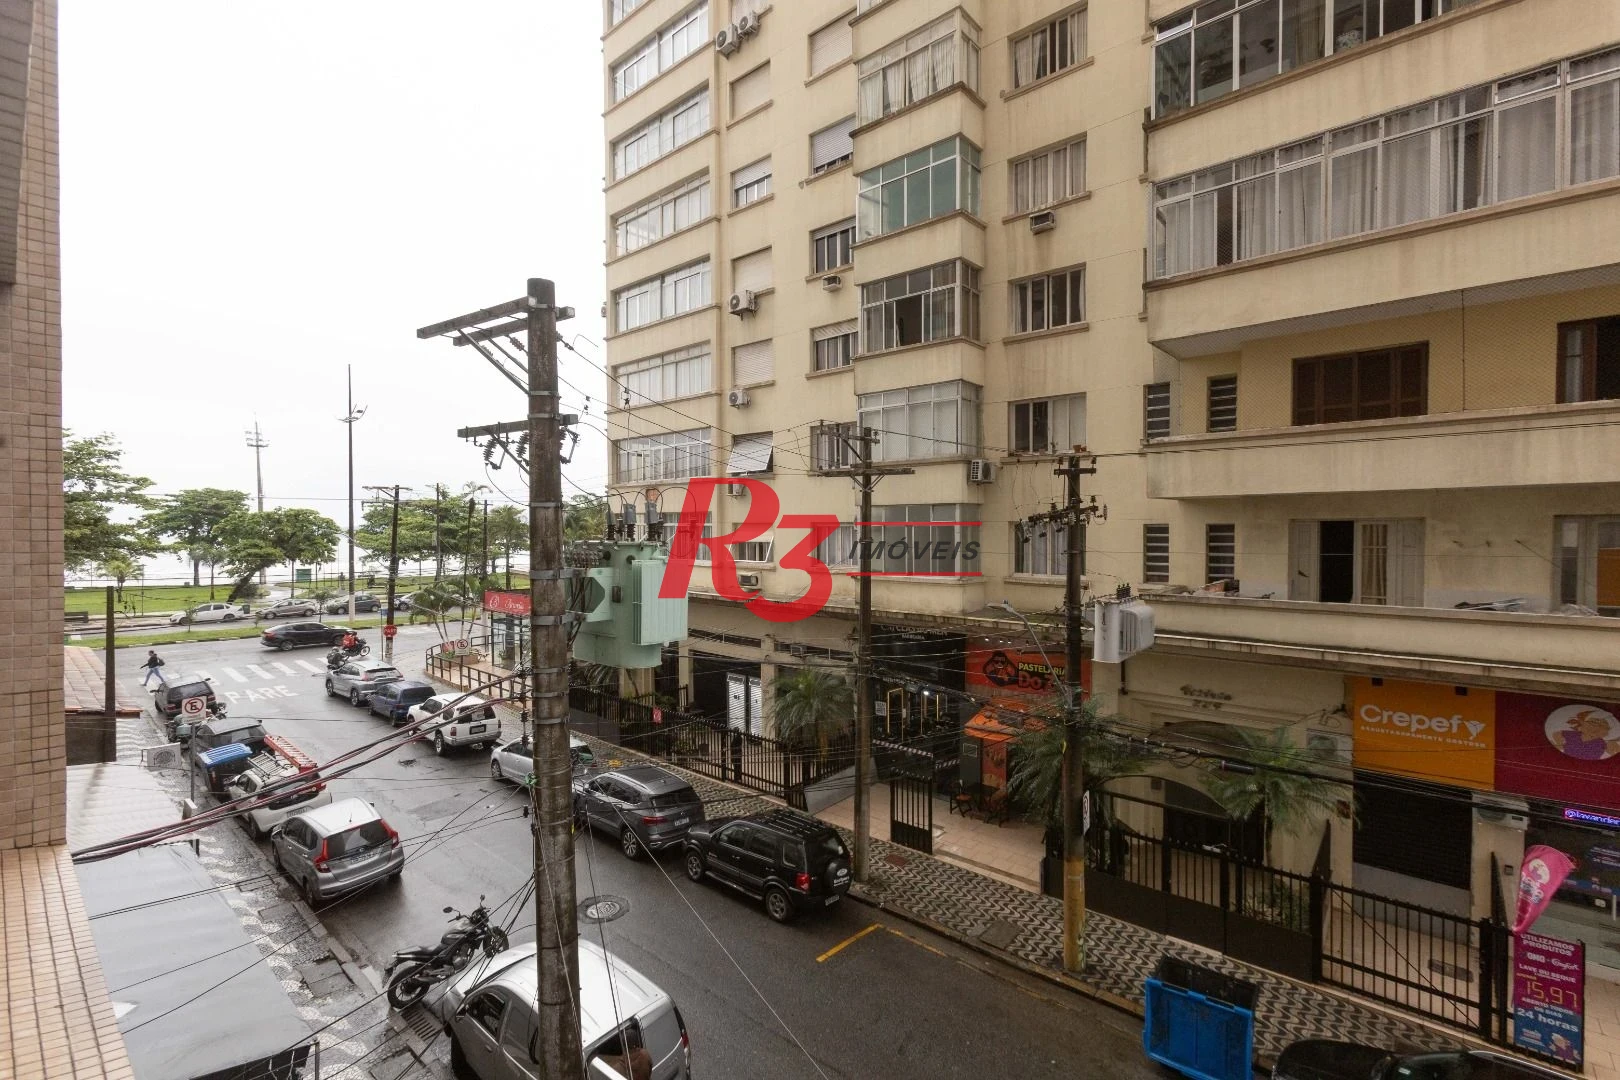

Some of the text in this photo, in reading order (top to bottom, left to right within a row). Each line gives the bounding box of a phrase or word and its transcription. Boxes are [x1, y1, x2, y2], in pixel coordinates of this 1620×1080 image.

[224, 684, 299, 704] PARE
[1521, 933, 1575, 952] UTILIZAMOS
[1522, 939, 1573, 957] PRODUTOS
[1517, 1007, 1579, 1033] 24 horas
